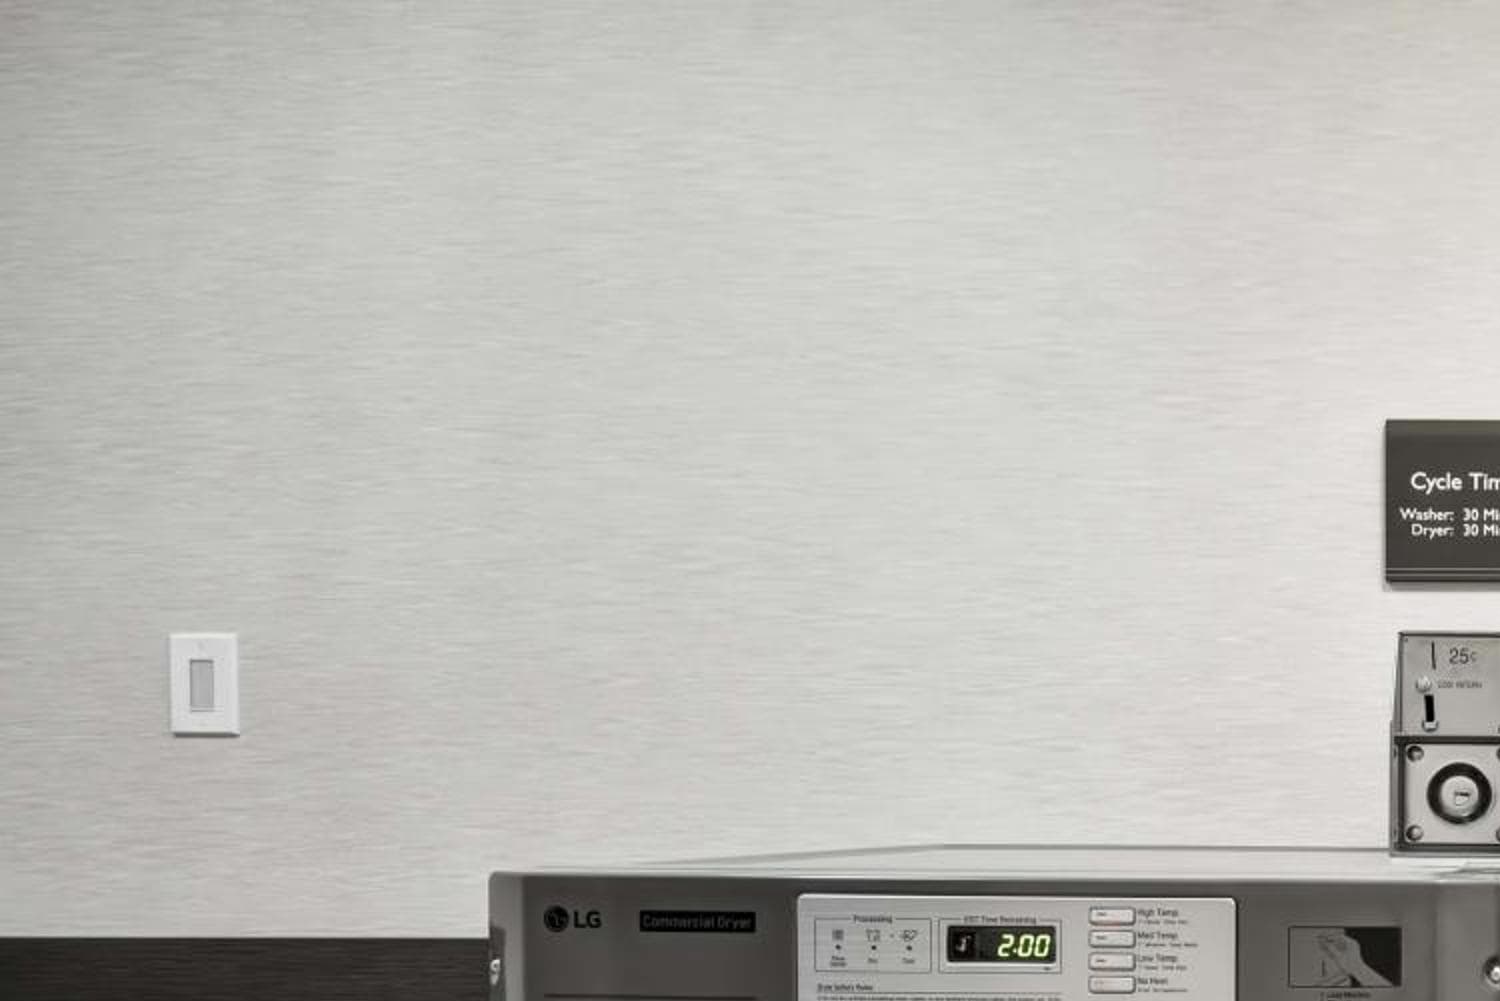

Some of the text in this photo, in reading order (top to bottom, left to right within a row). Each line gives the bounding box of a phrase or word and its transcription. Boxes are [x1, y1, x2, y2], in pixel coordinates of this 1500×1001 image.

[1410, 471, 1463, 495] Cycle
[1400, 507, 1455, 521] Washer:
[1463, 508, 1479, 521] 30
[1411, 523, 1455, 539] Dryer:
[1463, 523, 1479, 537] 30
[574, 911, 602, 928] LG
[642, 914, 715, 928] Commercial
